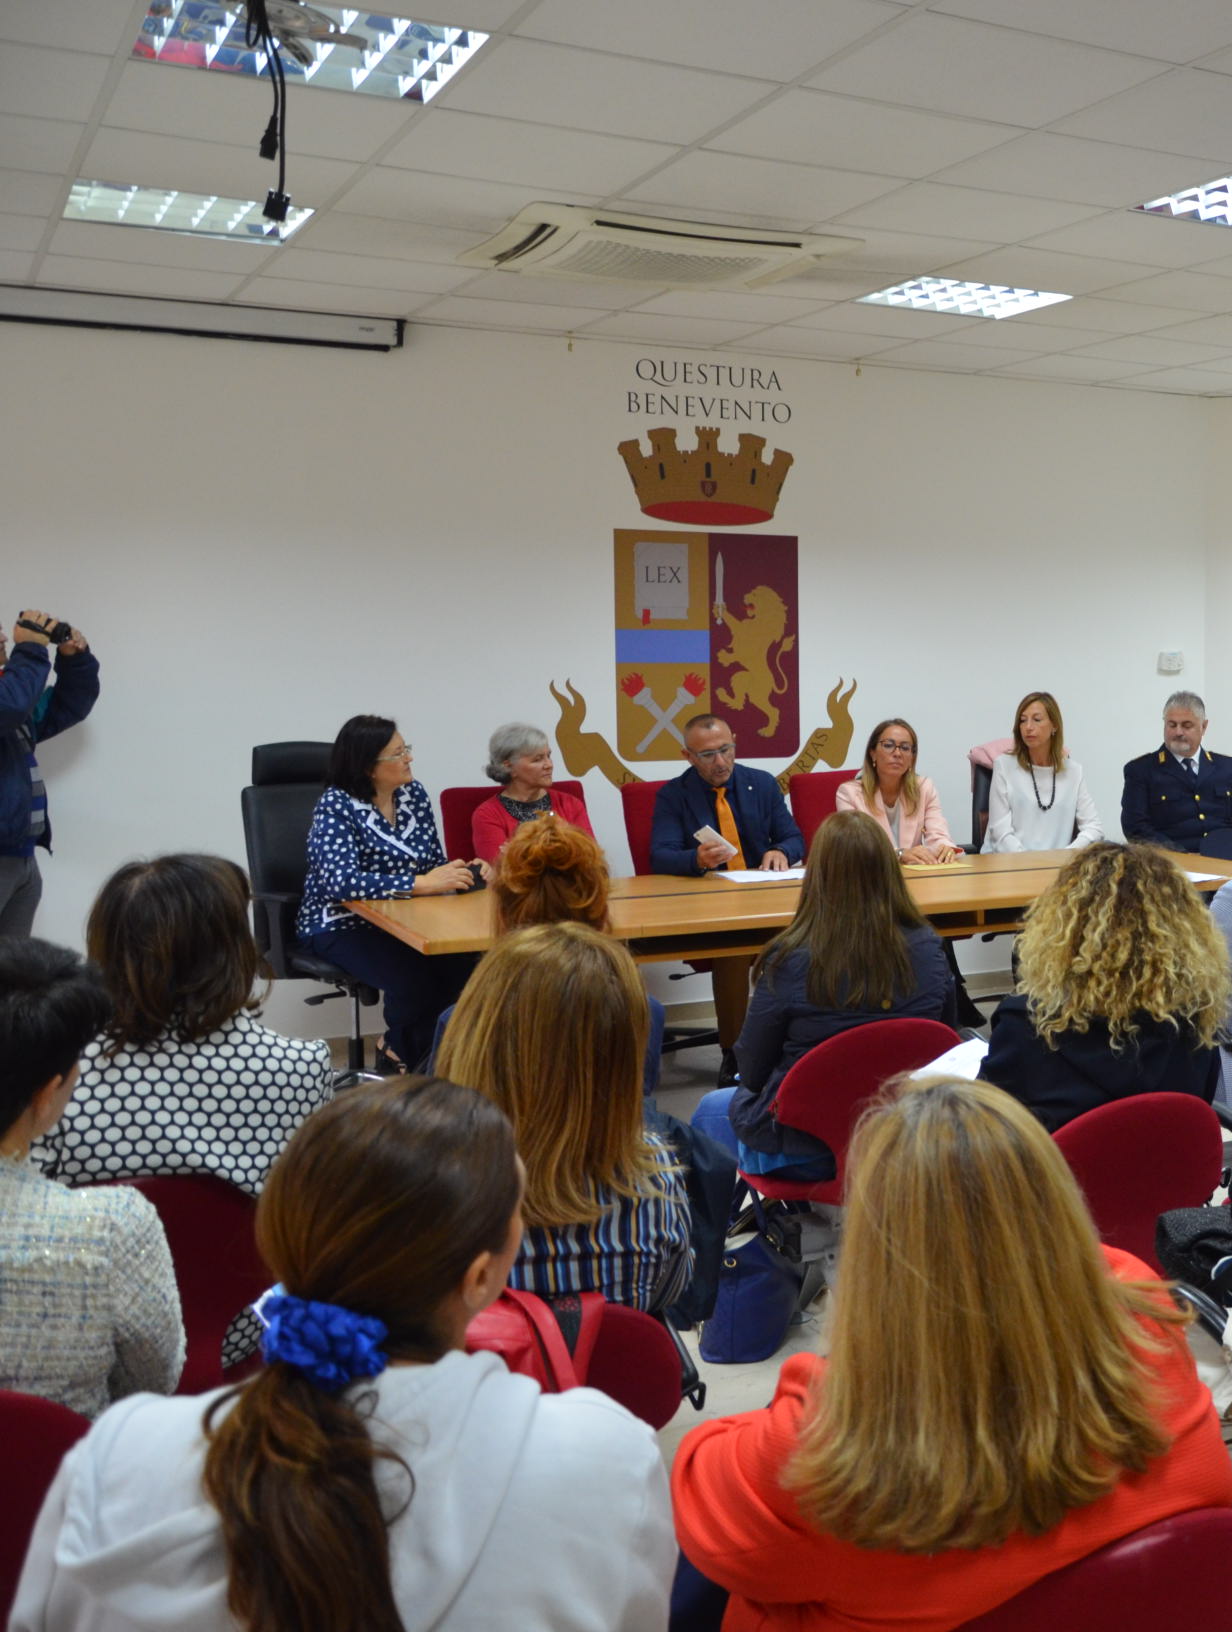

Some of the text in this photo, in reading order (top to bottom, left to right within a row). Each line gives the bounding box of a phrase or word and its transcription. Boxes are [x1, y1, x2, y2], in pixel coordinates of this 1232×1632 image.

[635, 358, 782, 391] QUESTURA
[626, 391, 792, 424] BENEVENTO
[644, 565, 682, 584] LEX
